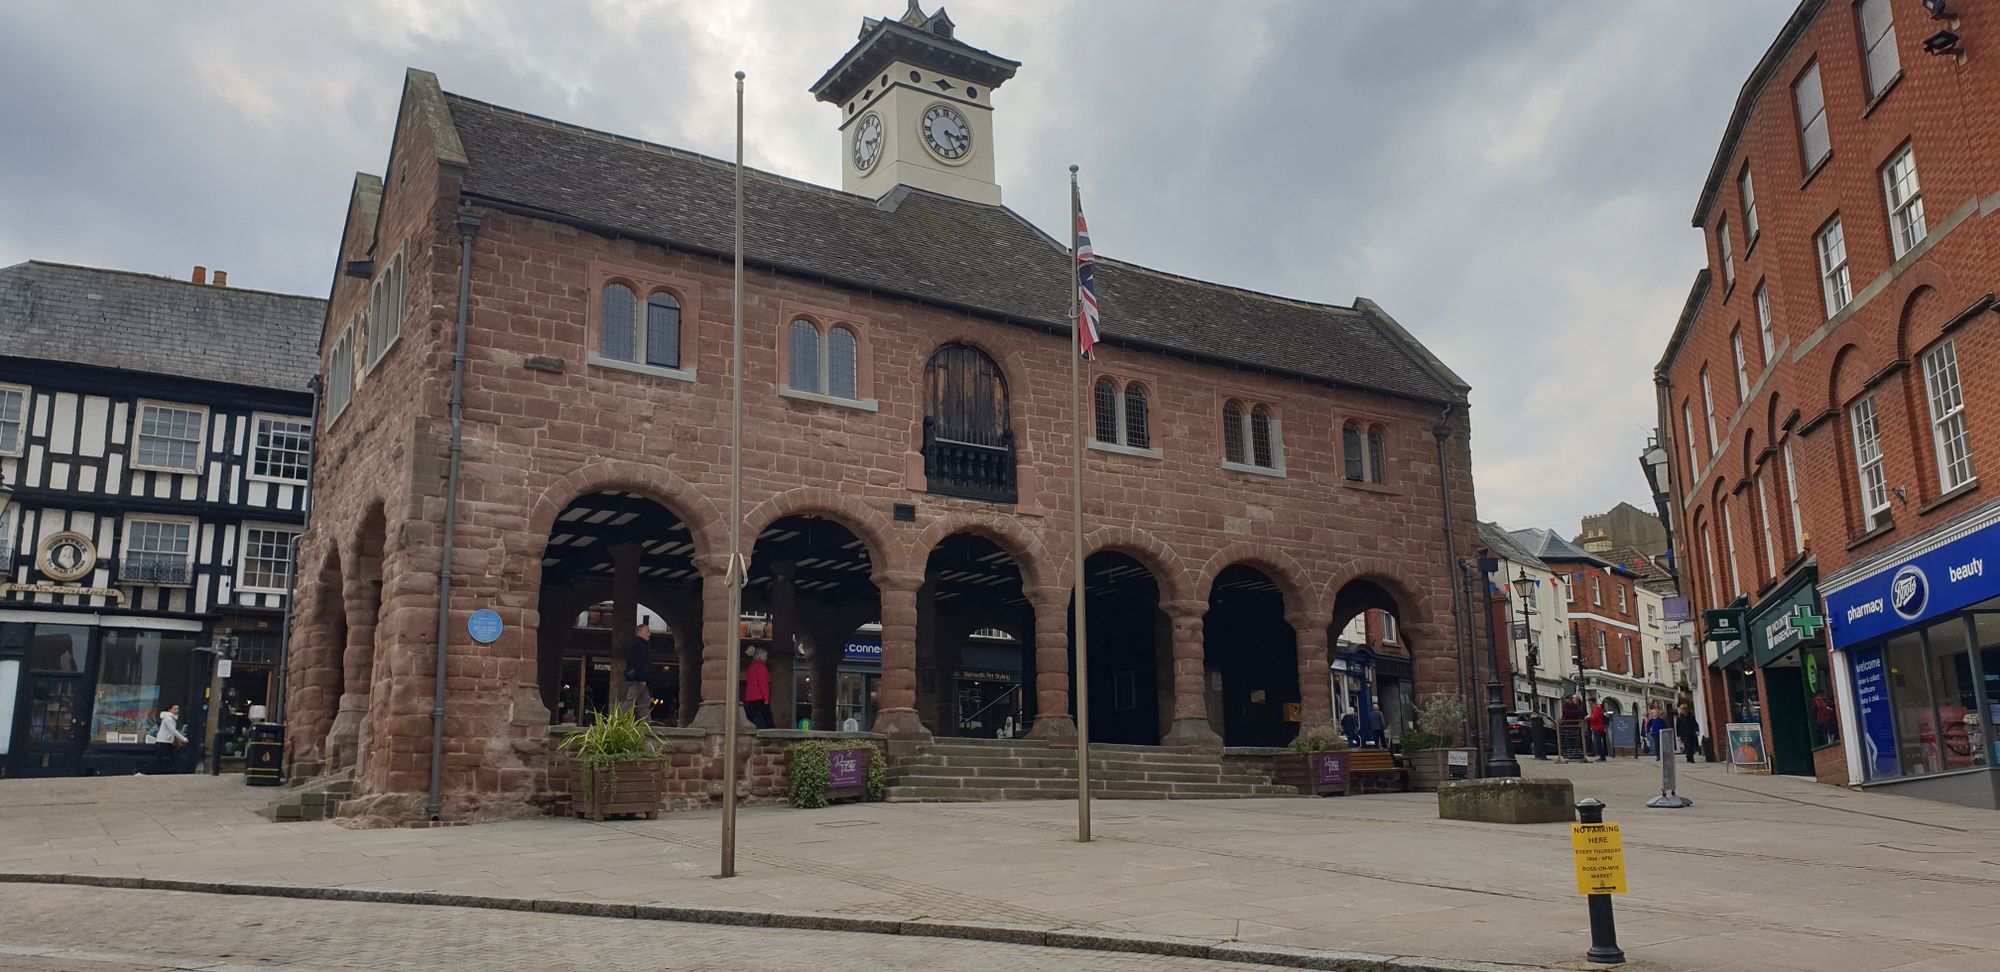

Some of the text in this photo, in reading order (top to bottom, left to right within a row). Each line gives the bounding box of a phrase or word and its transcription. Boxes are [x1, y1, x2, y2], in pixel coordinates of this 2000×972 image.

[1949, 557, 1983, 583] beauty
[1894, 575, 1917, 608] Boots
[1847, 598, 1884, 624] pharmacy
[1856, 658, 1881, 673] welcome
[1573, 825, 1619, 834] NO PARKING
[1588, 836, 1608, 844] HERE
